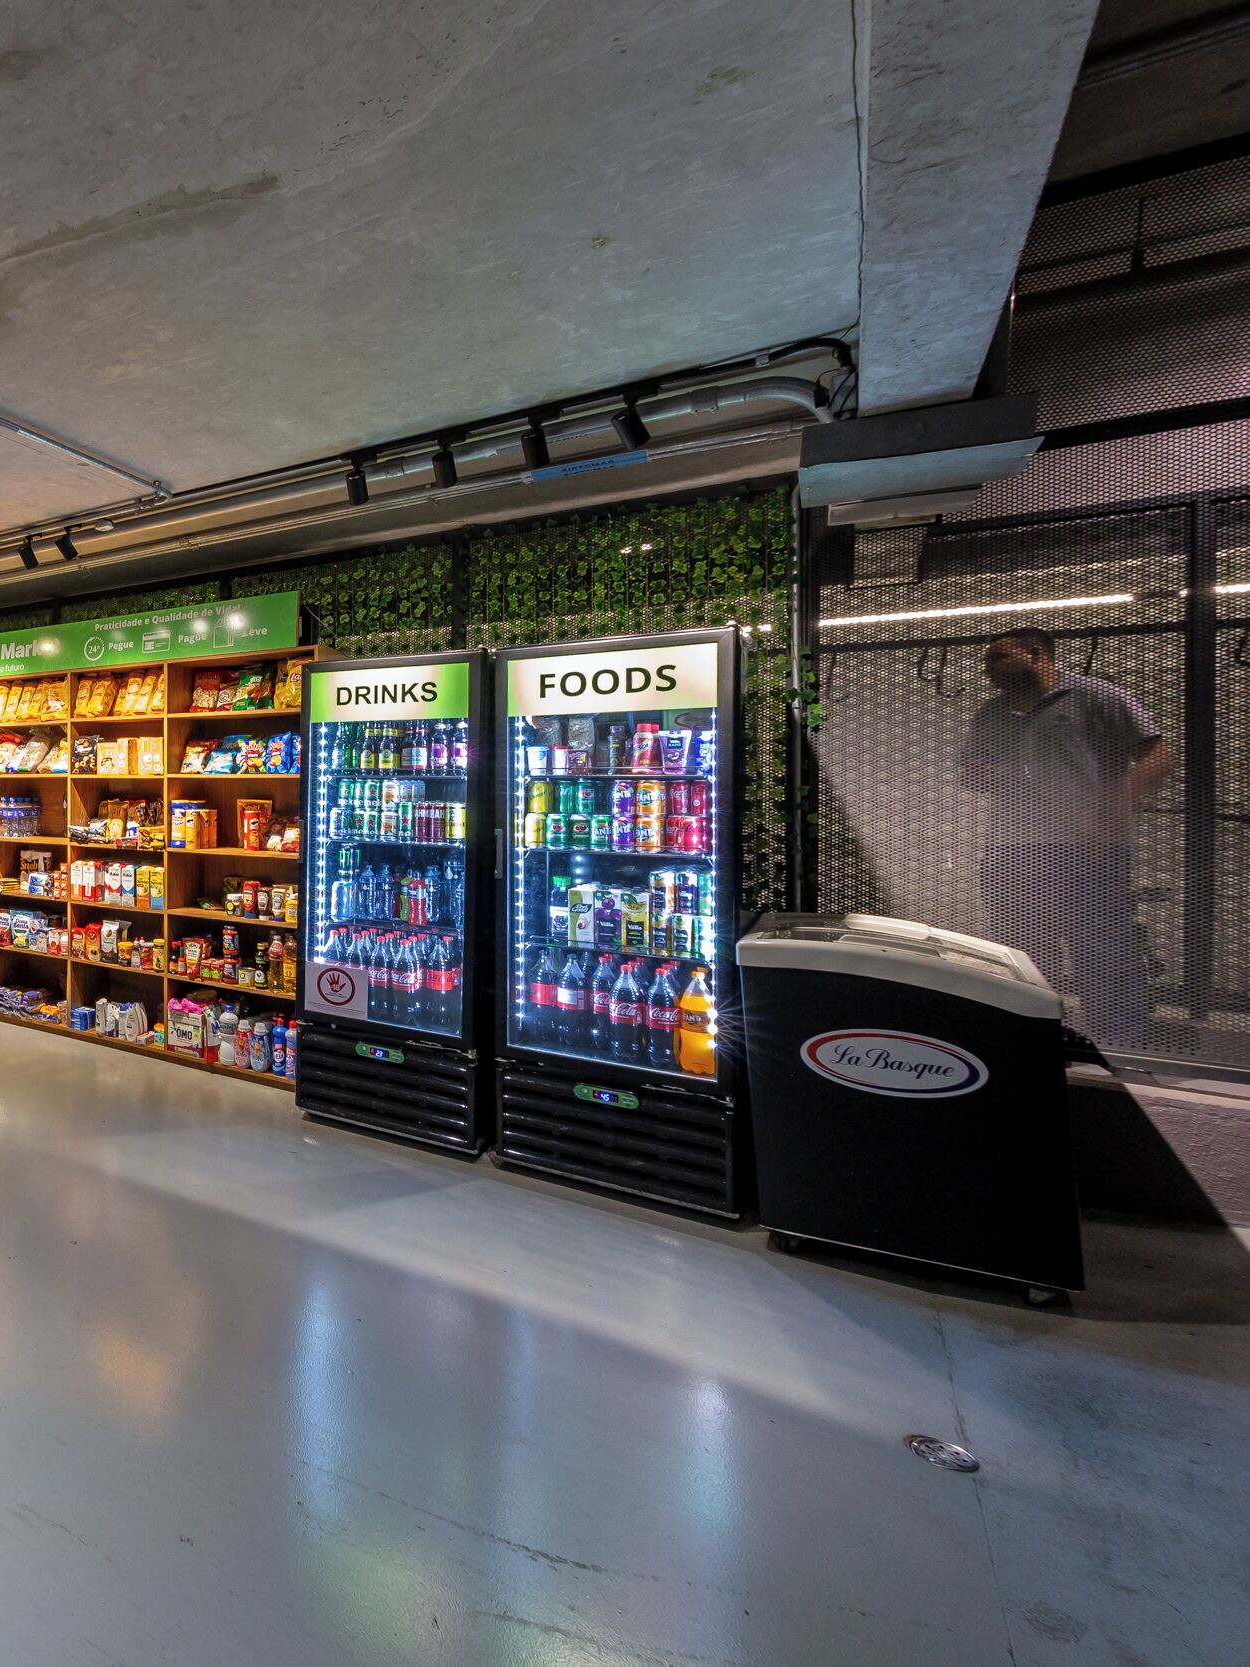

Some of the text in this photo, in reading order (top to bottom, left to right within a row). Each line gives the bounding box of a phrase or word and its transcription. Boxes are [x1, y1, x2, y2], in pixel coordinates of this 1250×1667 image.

[94, 619, 143, 632] Praticidade
[152, 610, 199, 624] Qualidade
[201, 608, 213, 617] de
[108, 641, 134, 651] Pegue
[178, 632, 207, 644] Pague
[5, 663, 25, 672] futuro
[335, 681, 439, 706] DRINKS
[538, 664, 677, 699] FOODS
[830, 1044, 955, 1079] La Basque
